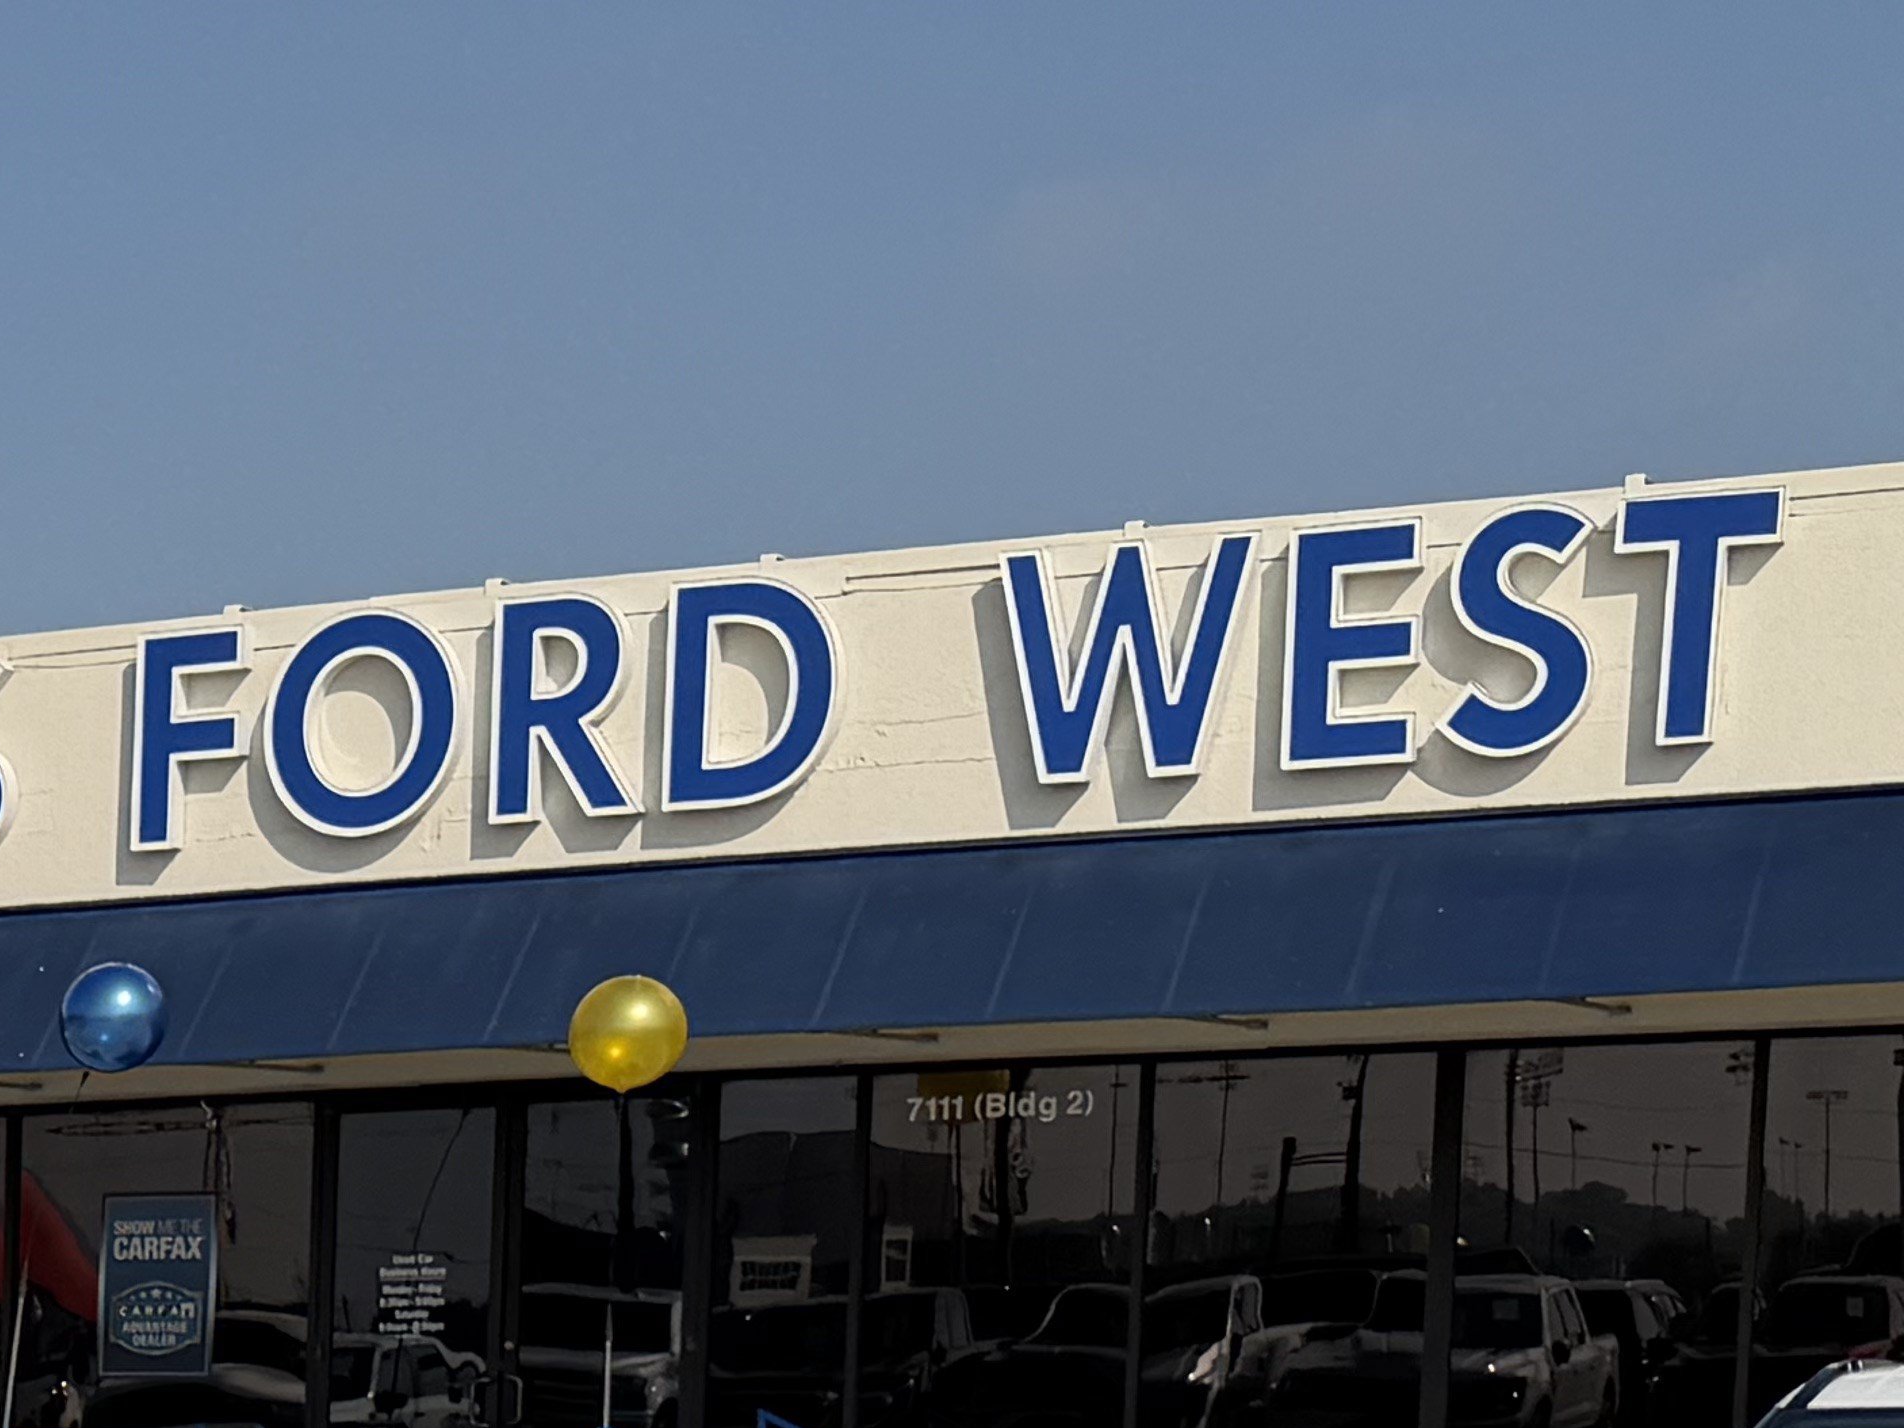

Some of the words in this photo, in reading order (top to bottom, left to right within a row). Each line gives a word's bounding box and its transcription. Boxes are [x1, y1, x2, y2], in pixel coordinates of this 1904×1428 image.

[130, 576, 844, 855] FORD
[998, 487, 1787, 787] WEST
[906, 1095, 964, 1122] 7111
[974, 1091, 1058, 1123] (Bldg
[1066, 1090, 1094, 1117] 2)
[113, 1236, 204, 1261] CARFAX
